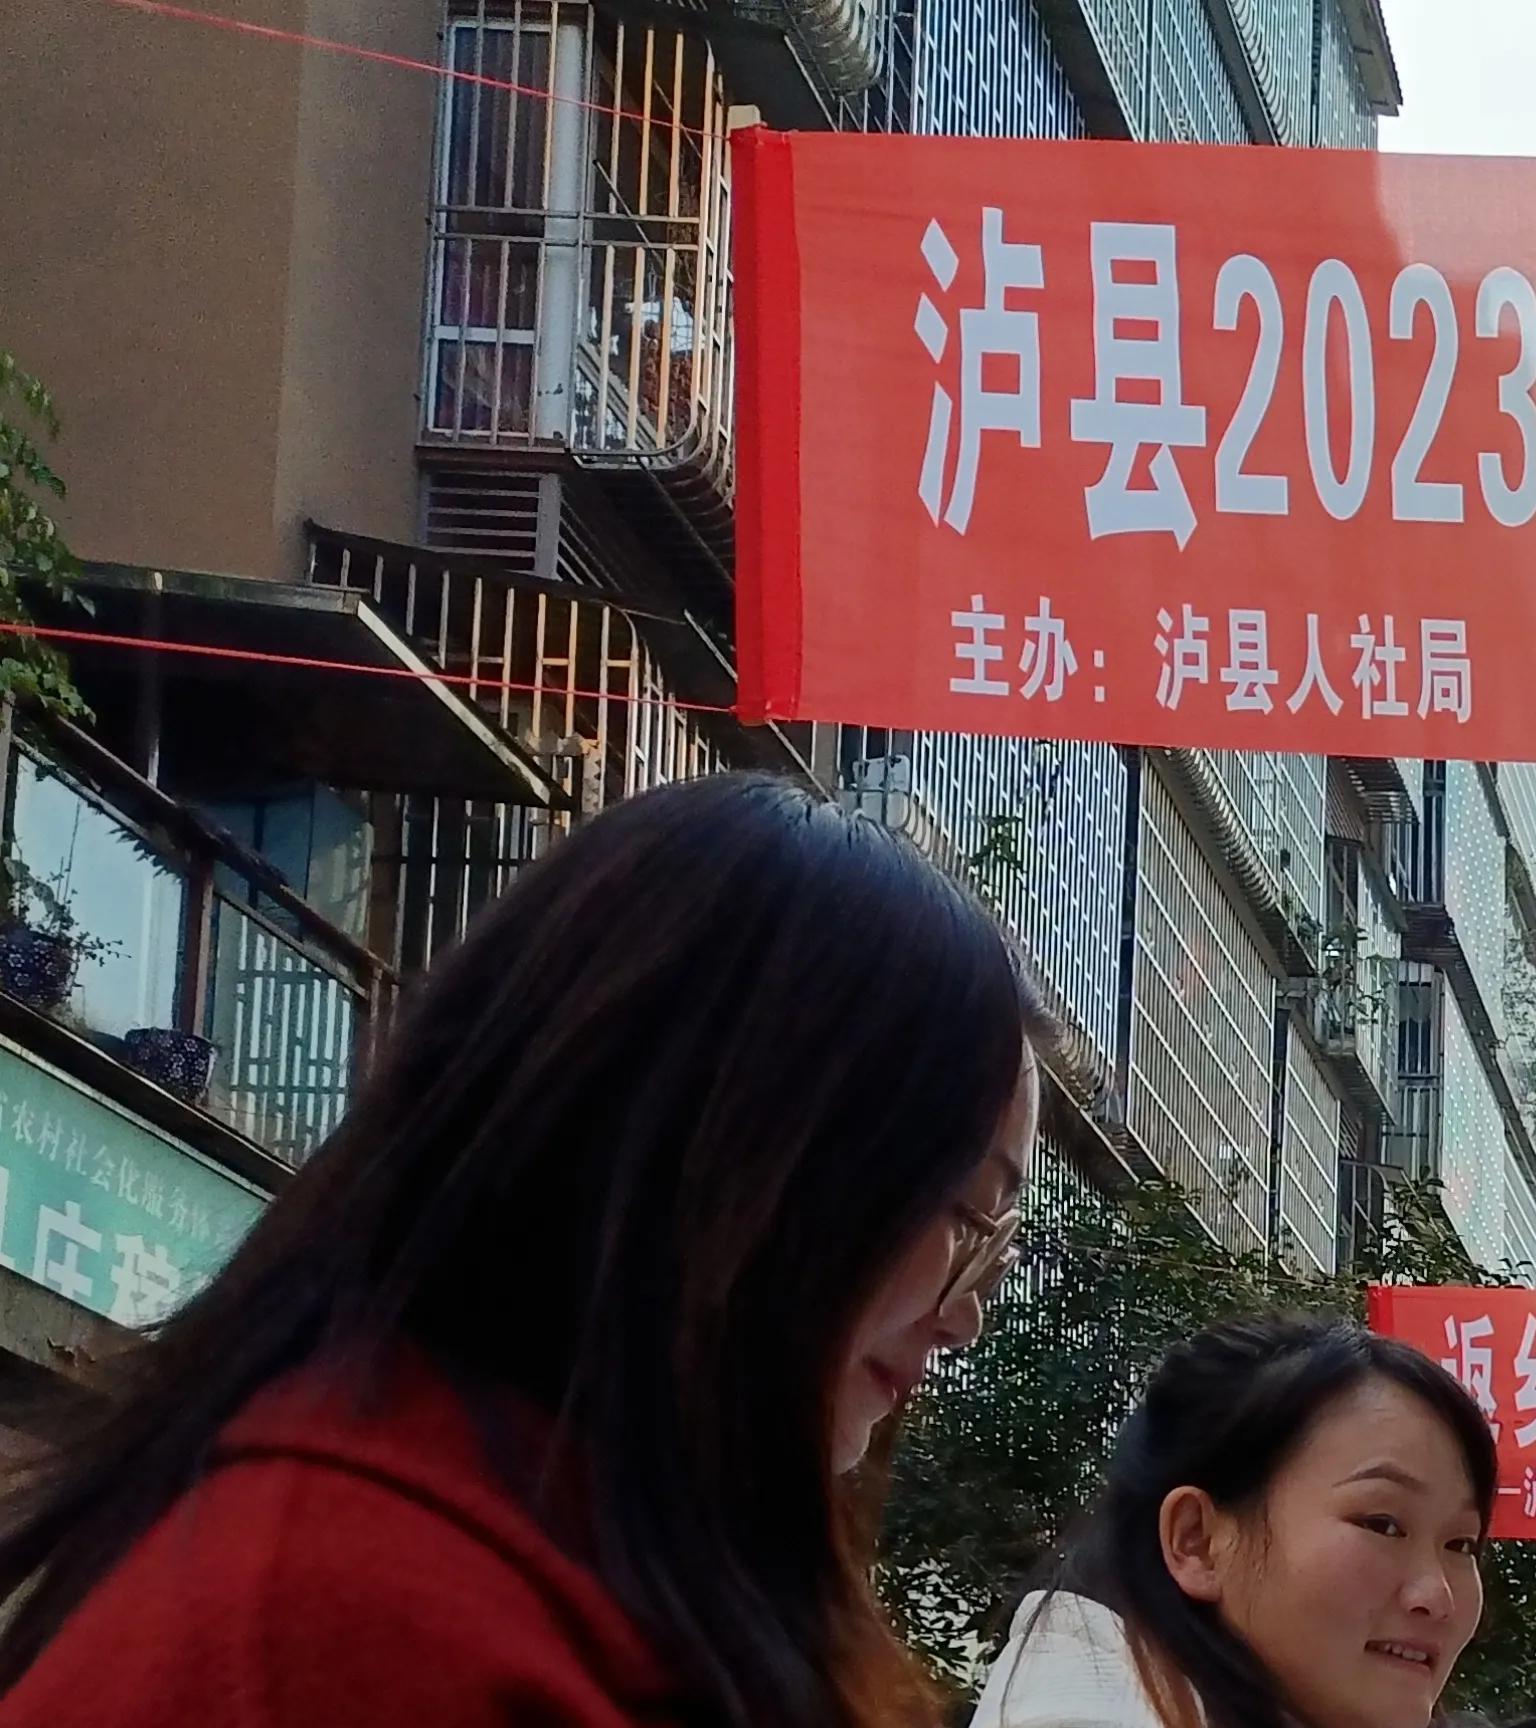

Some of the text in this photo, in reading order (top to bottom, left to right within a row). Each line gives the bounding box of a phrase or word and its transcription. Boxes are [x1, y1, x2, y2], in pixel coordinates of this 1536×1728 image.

[1154, 604, 1474, 724] 泸县人社局
